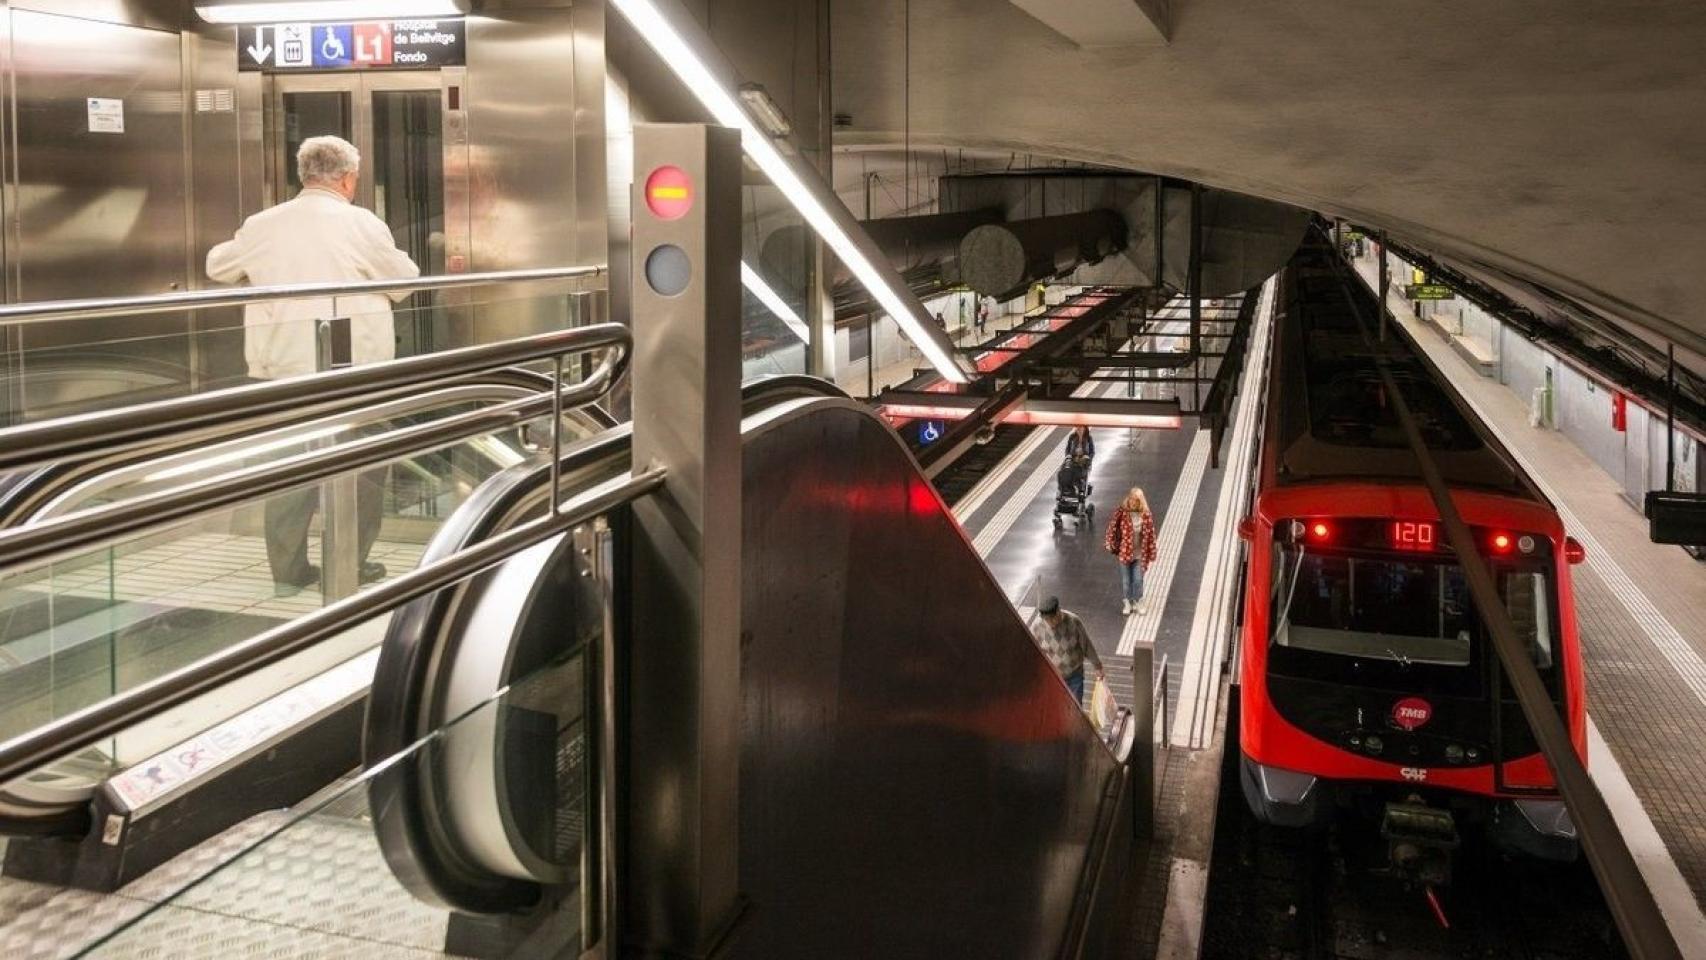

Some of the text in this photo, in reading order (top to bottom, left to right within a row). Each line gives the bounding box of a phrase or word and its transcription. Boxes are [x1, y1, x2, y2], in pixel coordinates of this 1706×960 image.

[394, 32, 455, 45] de Bellvitge
[356, 34, 382, 61] L1
[394, 51, 427, 62] Fondo
[1395, 522, 1431, 543] 120
[1400, 707, 1427, 719] TMB
[1400, 767, 1427, 781] CAF
